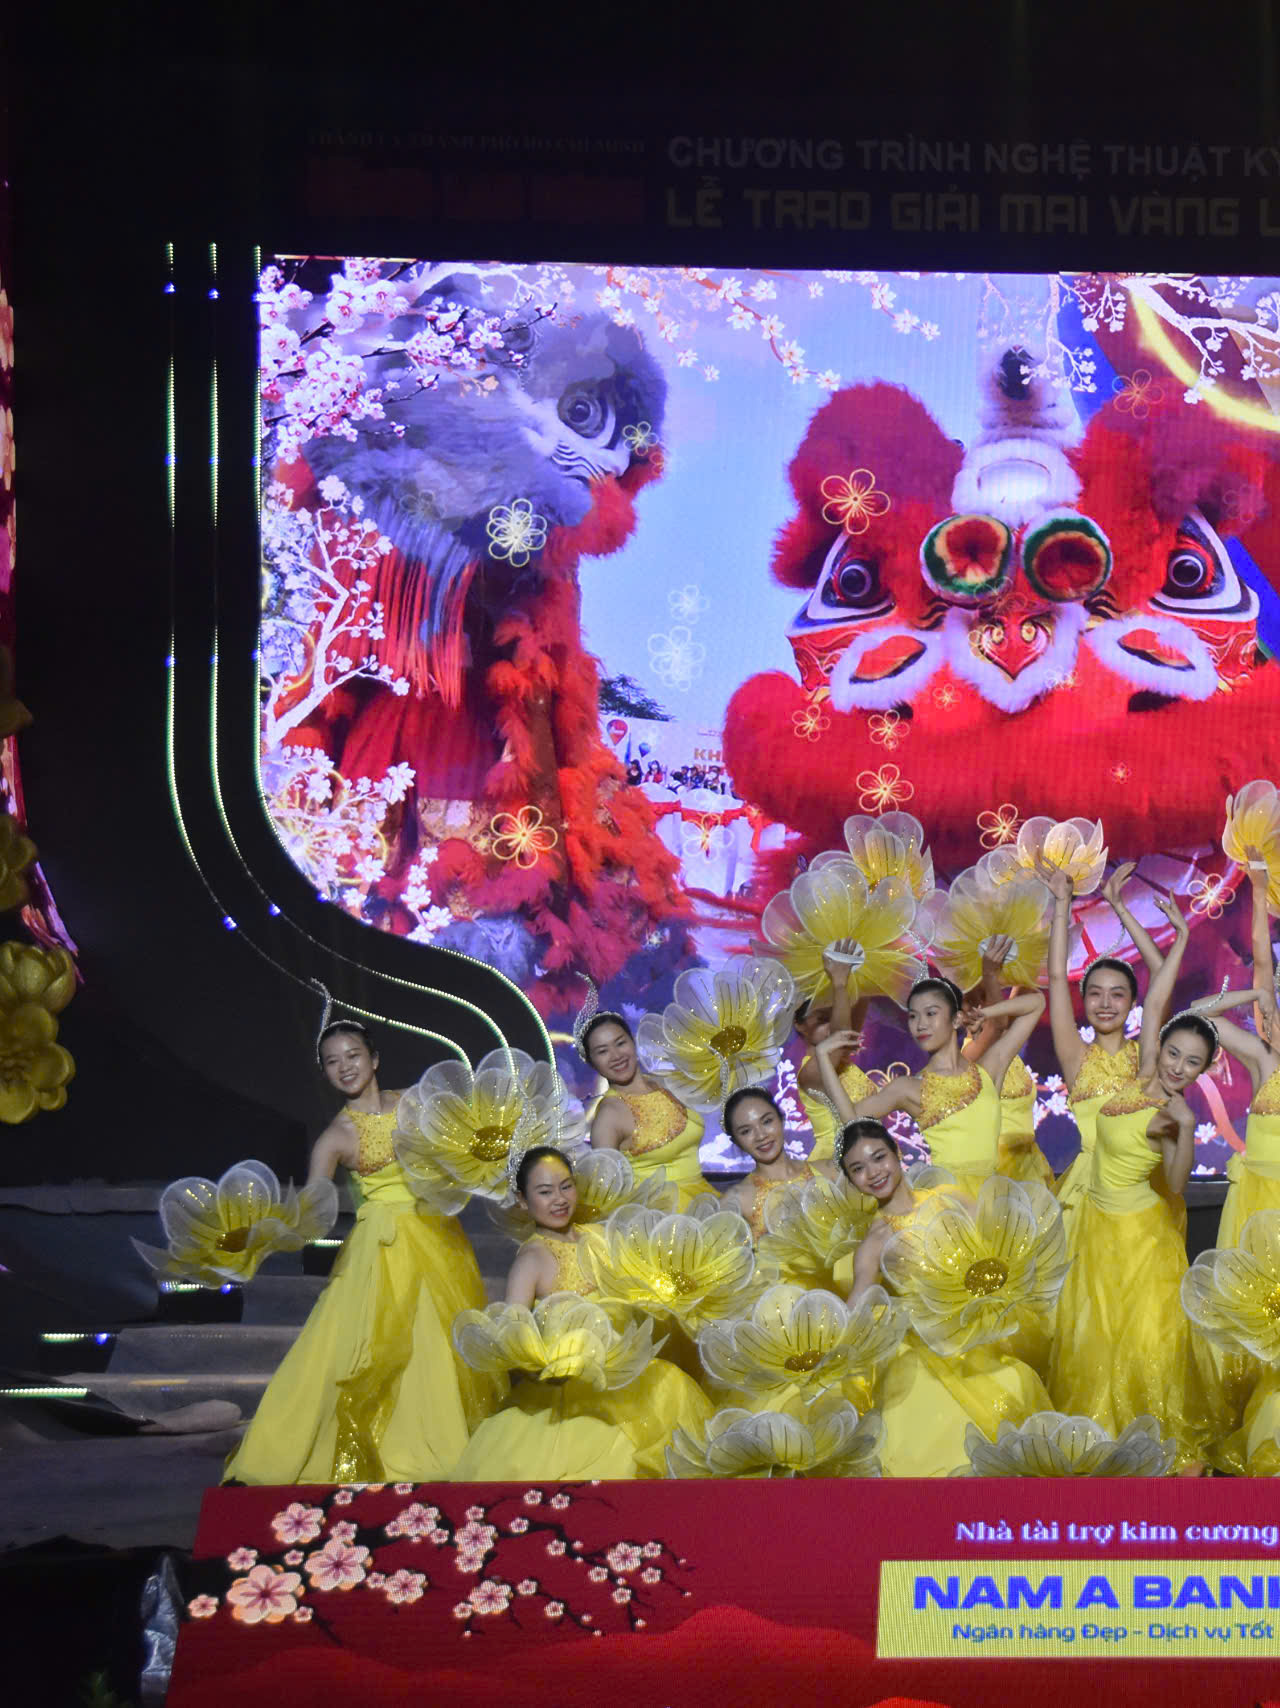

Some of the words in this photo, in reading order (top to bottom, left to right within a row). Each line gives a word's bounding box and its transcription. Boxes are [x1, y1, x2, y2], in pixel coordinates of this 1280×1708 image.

[667, 136, 845, 170] CHƯƠNG
[856, 134, 972, 172] TRÌNH
[984, 135, 1092, 182] NGHỆ
[1104, 136, 1231, 185] THUẬT
[665, 175, 723, 228] LỄ
[743, 188, 871, 231] TRAO
[889, 182, 979, 232] GIẢI
[955, 1521, 1014, 1543] Nhà
[1022, 1520, 1060, 1543] tài
[1067, 1522, 1115, 1545] trợ
[1120, 1521, 1178, 1543] kim
[1184, 1523, 1279, 1546] cương
[913, 1575, 1062, 1609] NAM
[1074, 1575, 1121, 1609] A
[952, 1622, 1014, 1643] Ngân
[1019, 1622, 1076, 1643] hàng
[1081, 1622, 1129, 1642] Đẹp
[1148, 1622, 1199, 1643] Dịch
[1204, 1626, 1230, 1643] vụ
[1235, 1619, 1274, 1640] Tốt
